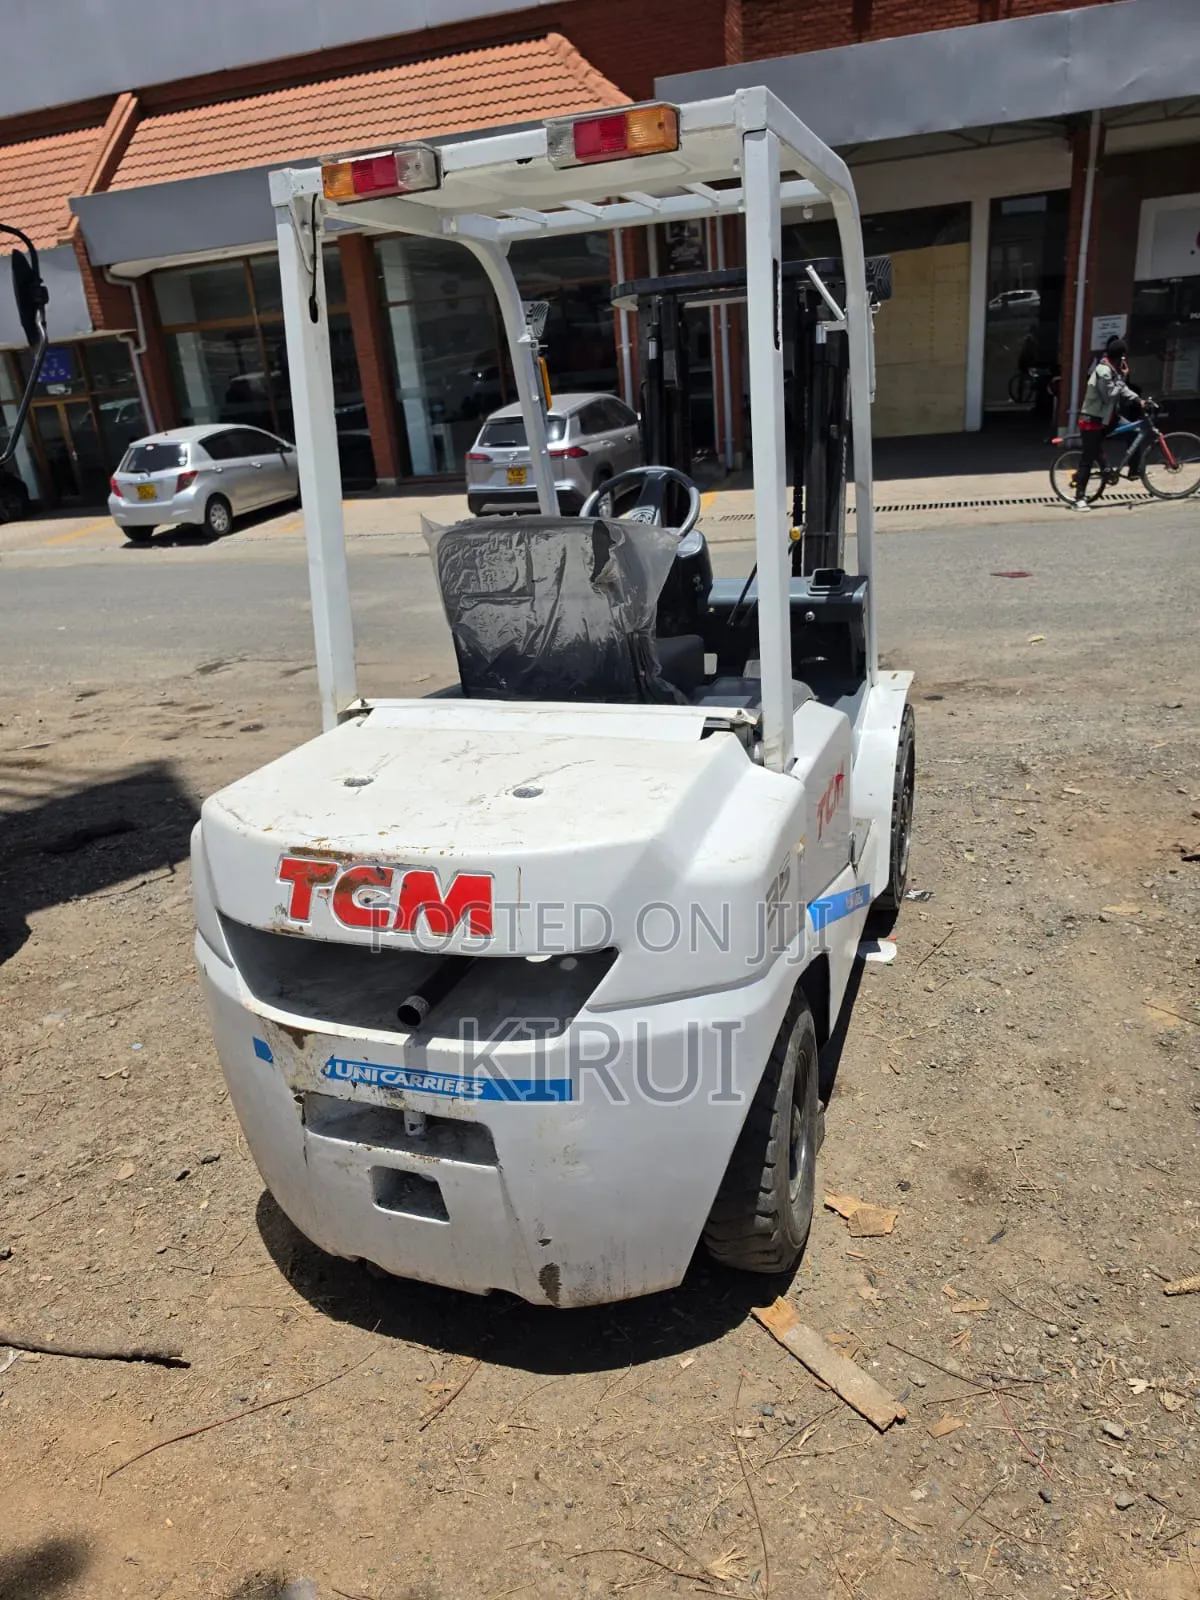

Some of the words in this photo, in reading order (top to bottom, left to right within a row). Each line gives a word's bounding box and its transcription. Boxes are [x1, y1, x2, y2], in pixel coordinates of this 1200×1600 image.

[816, 760, 845, 841] TCM
[276, 853, 496, 942] TCM
[334, 1060, 486, 1097] UNICARRIERS
